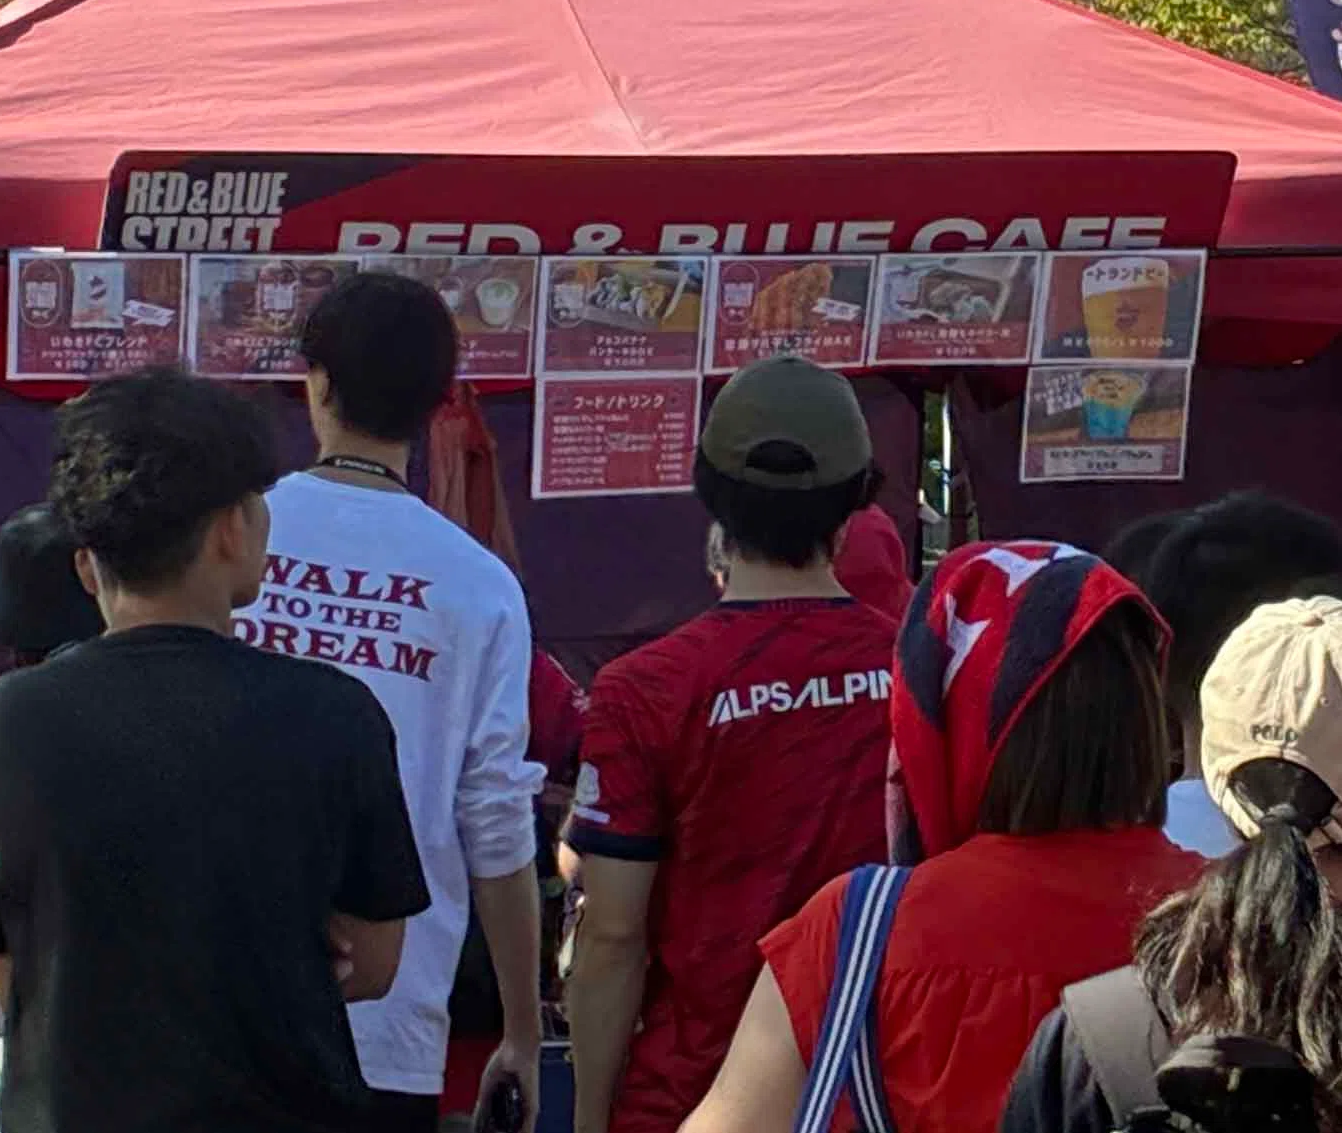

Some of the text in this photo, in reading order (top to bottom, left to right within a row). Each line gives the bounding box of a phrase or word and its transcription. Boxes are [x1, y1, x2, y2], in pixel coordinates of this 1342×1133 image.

[124, 171, 290, 216] RED&BLUE
[120, 216, 283, 252] STREET
[259, 553, 435, 612] WALK
[262, 591, 403, 634] TO THE
[233, 617, 439, 683] DREAM
